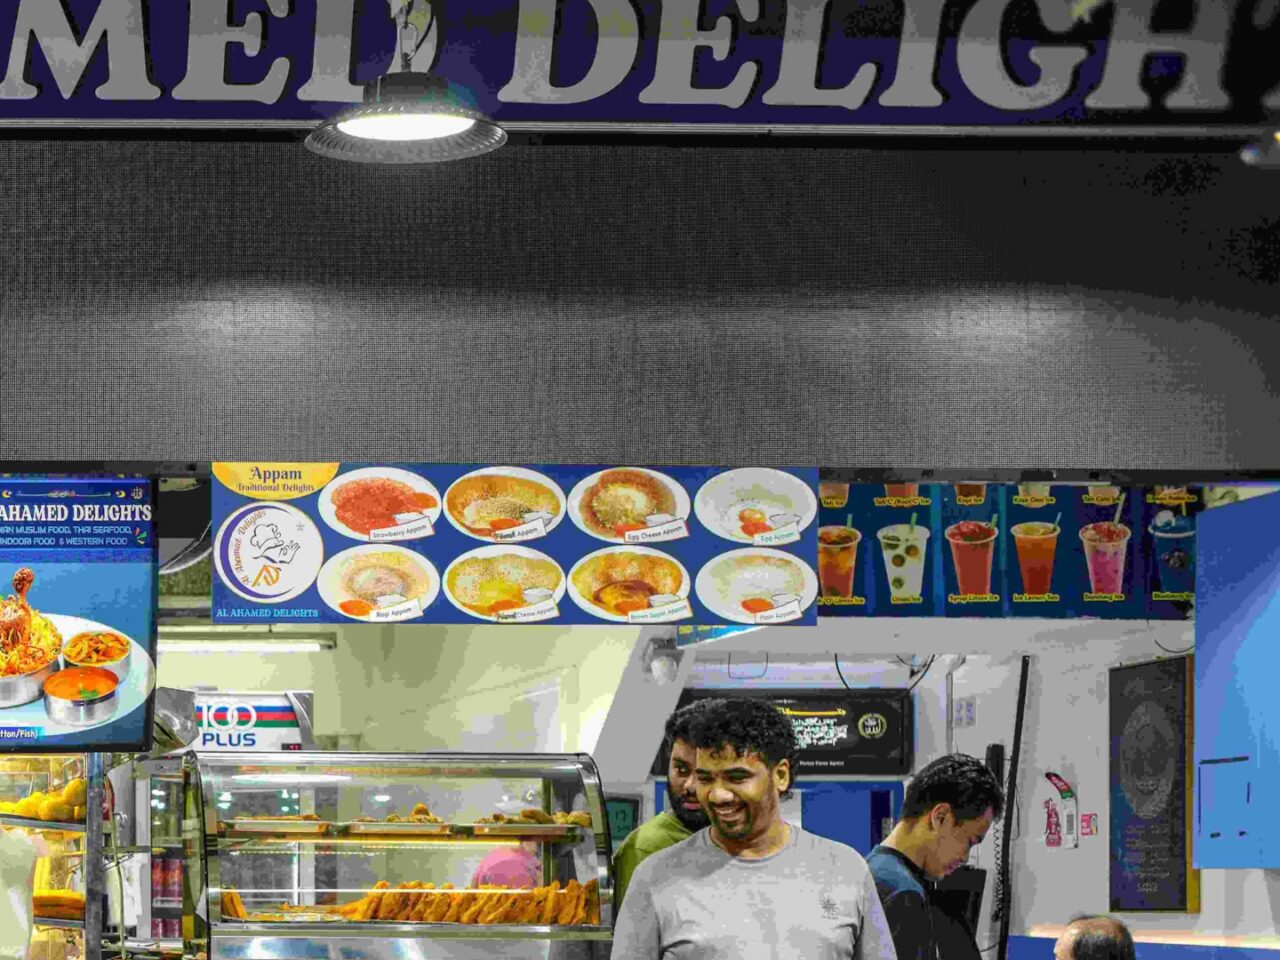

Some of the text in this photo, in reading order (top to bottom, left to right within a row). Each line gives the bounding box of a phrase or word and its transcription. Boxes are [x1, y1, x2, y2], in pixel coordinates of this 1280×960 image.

[249, 466, 302, 484] Appam
[236, 483, 315, 493] Traditional Delights
[72, 504, 152, 522] DELIGHTS
[15, 526, 46, 534] MUSLIM
[73, 526, 92, 534] THAI
[372, 523, 427, 540] Strawberry Appam
[627, 533, 640, 542] Egg
[661, 524, 683, 536] Appam
[773, 530, 795, 541] Appam
[33, 537, 56, 545] FOOD
[65, 537, 104, 545] WESTERN
[105, 537, 128, 545] FOOD
[216, 608, 319, 617] AL AHAMED DELIGHTS
[391, 607, 412, 618] Appam
[202, 703, 257, 731] 100
[202, 733, 256, 747] PLUS
